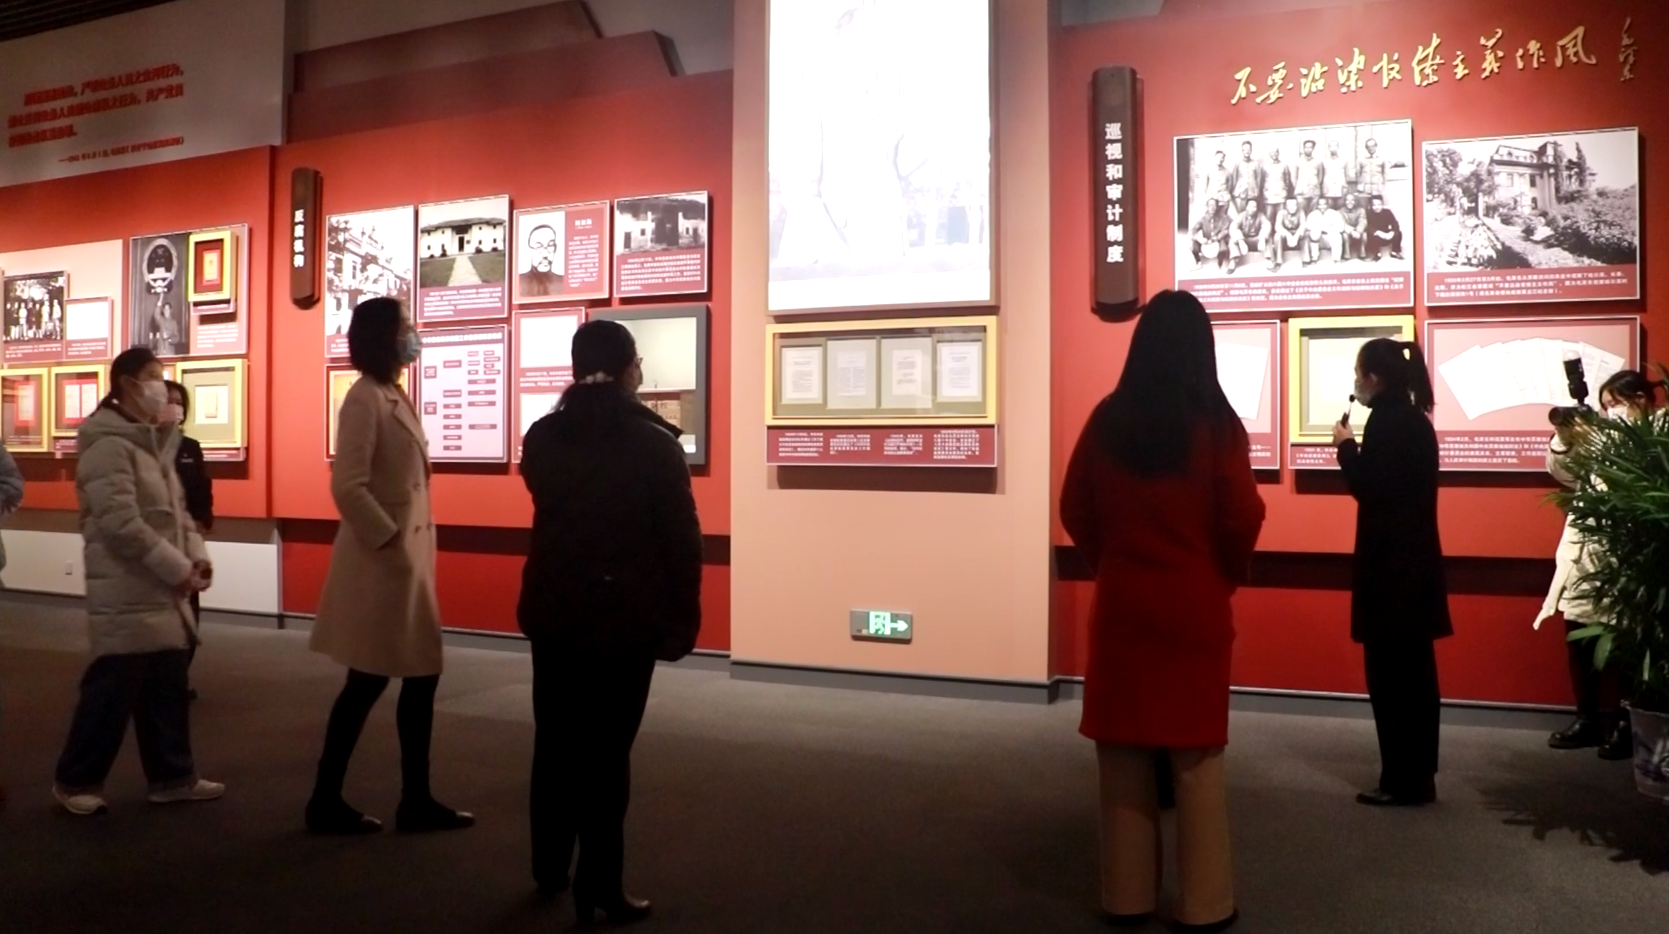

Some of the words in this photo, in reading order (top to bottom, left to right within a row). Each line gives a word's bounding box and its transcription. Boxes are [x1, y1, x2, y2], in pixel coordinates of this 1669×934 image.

[1105, 122, 1124, 264] 巡视和审计制度
